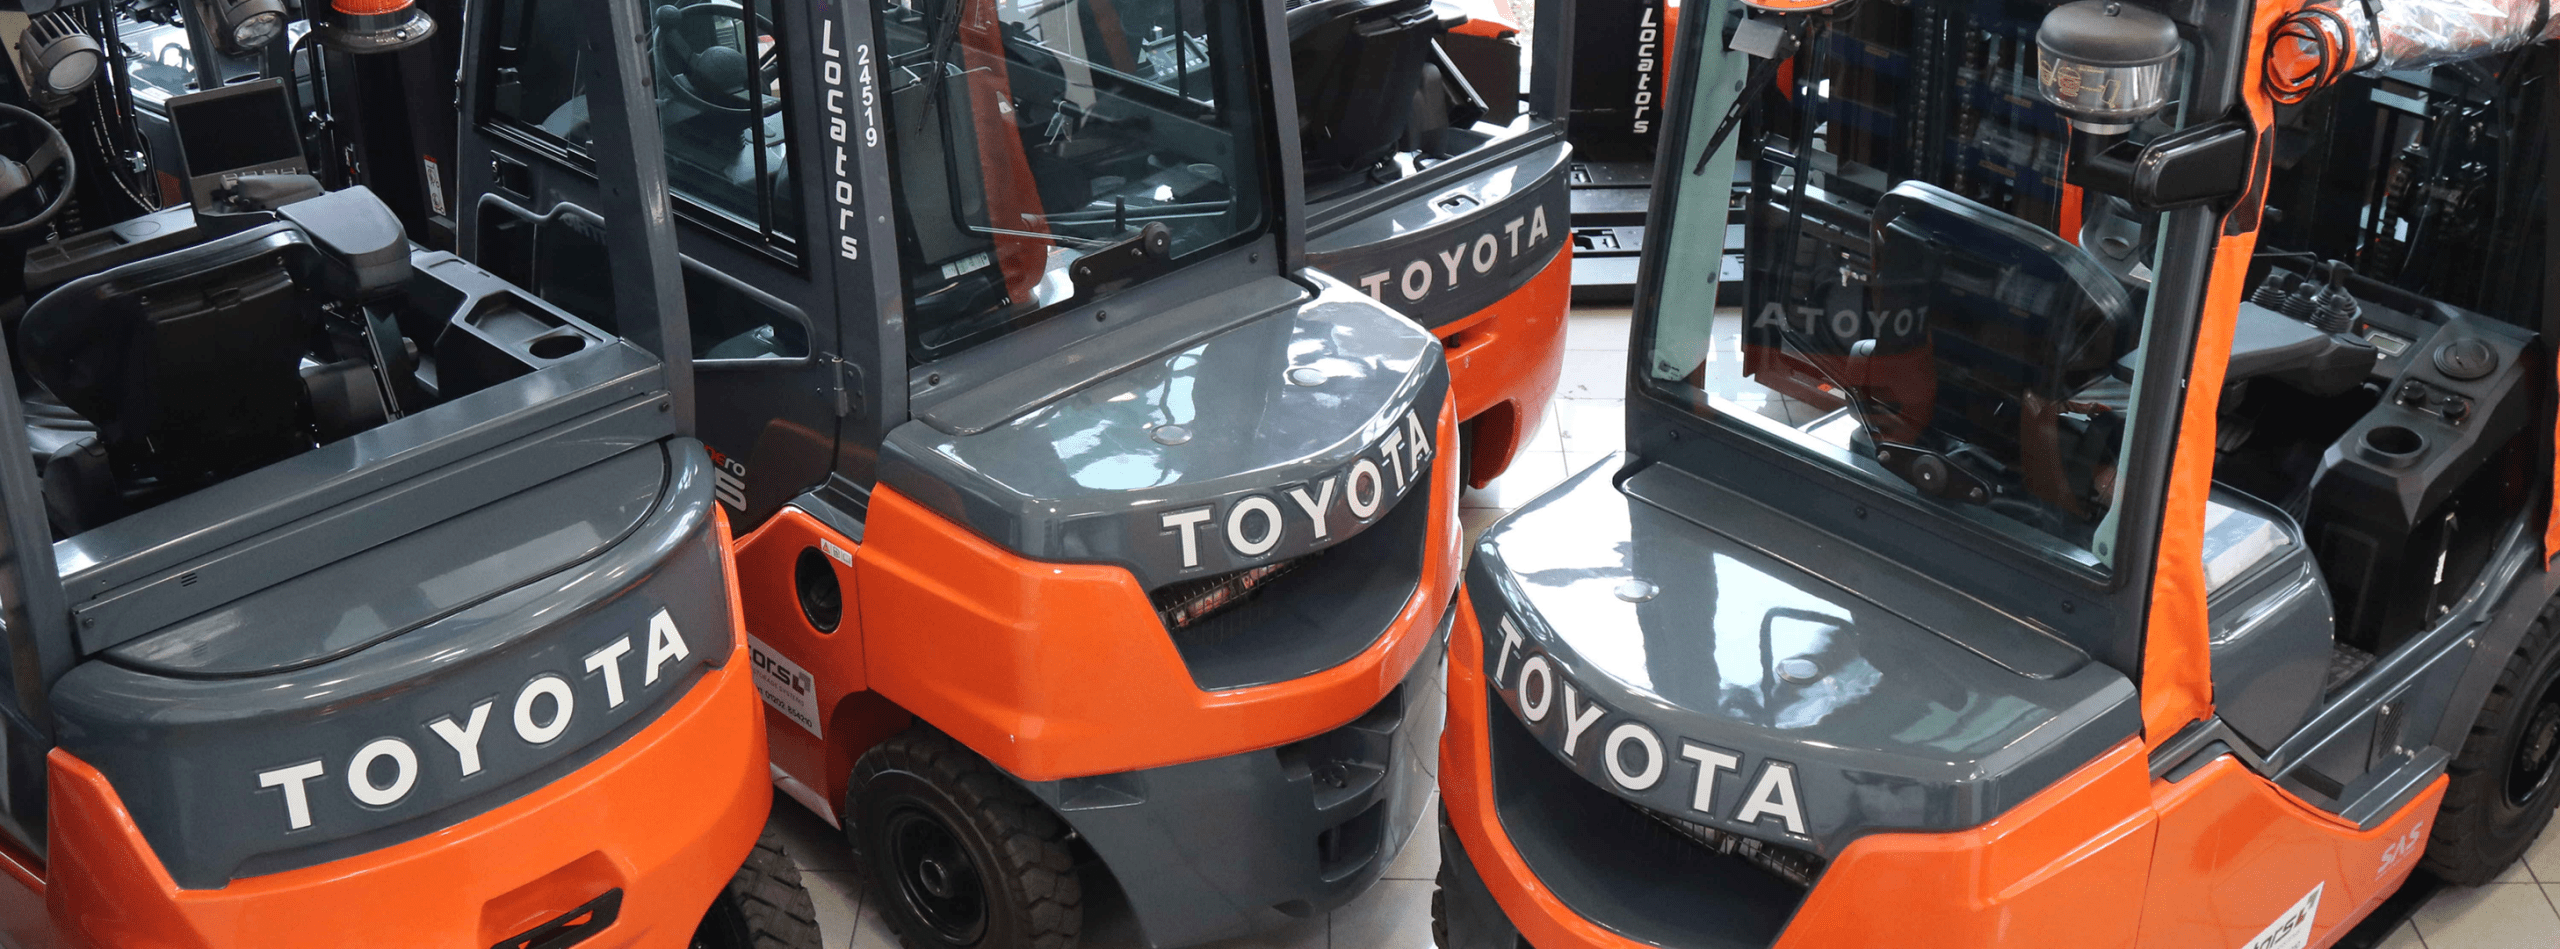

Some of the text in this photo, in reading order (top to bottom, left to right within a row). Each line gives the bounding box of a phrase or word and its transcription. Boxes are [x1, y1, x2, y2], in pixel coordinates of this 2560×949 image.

[822, 19, 857, 260] Locators
[857, 44, 878, 148] 24519
[1633, 8, 1657, 133] Locators
[1361, 205, 1549, 302] TOYOTA
[1162, 409, 1431, 568] TOYOTA
[259, 608, 690, 830] TOYOTA
[1495, 614, 1806, 835] TOYOTA
